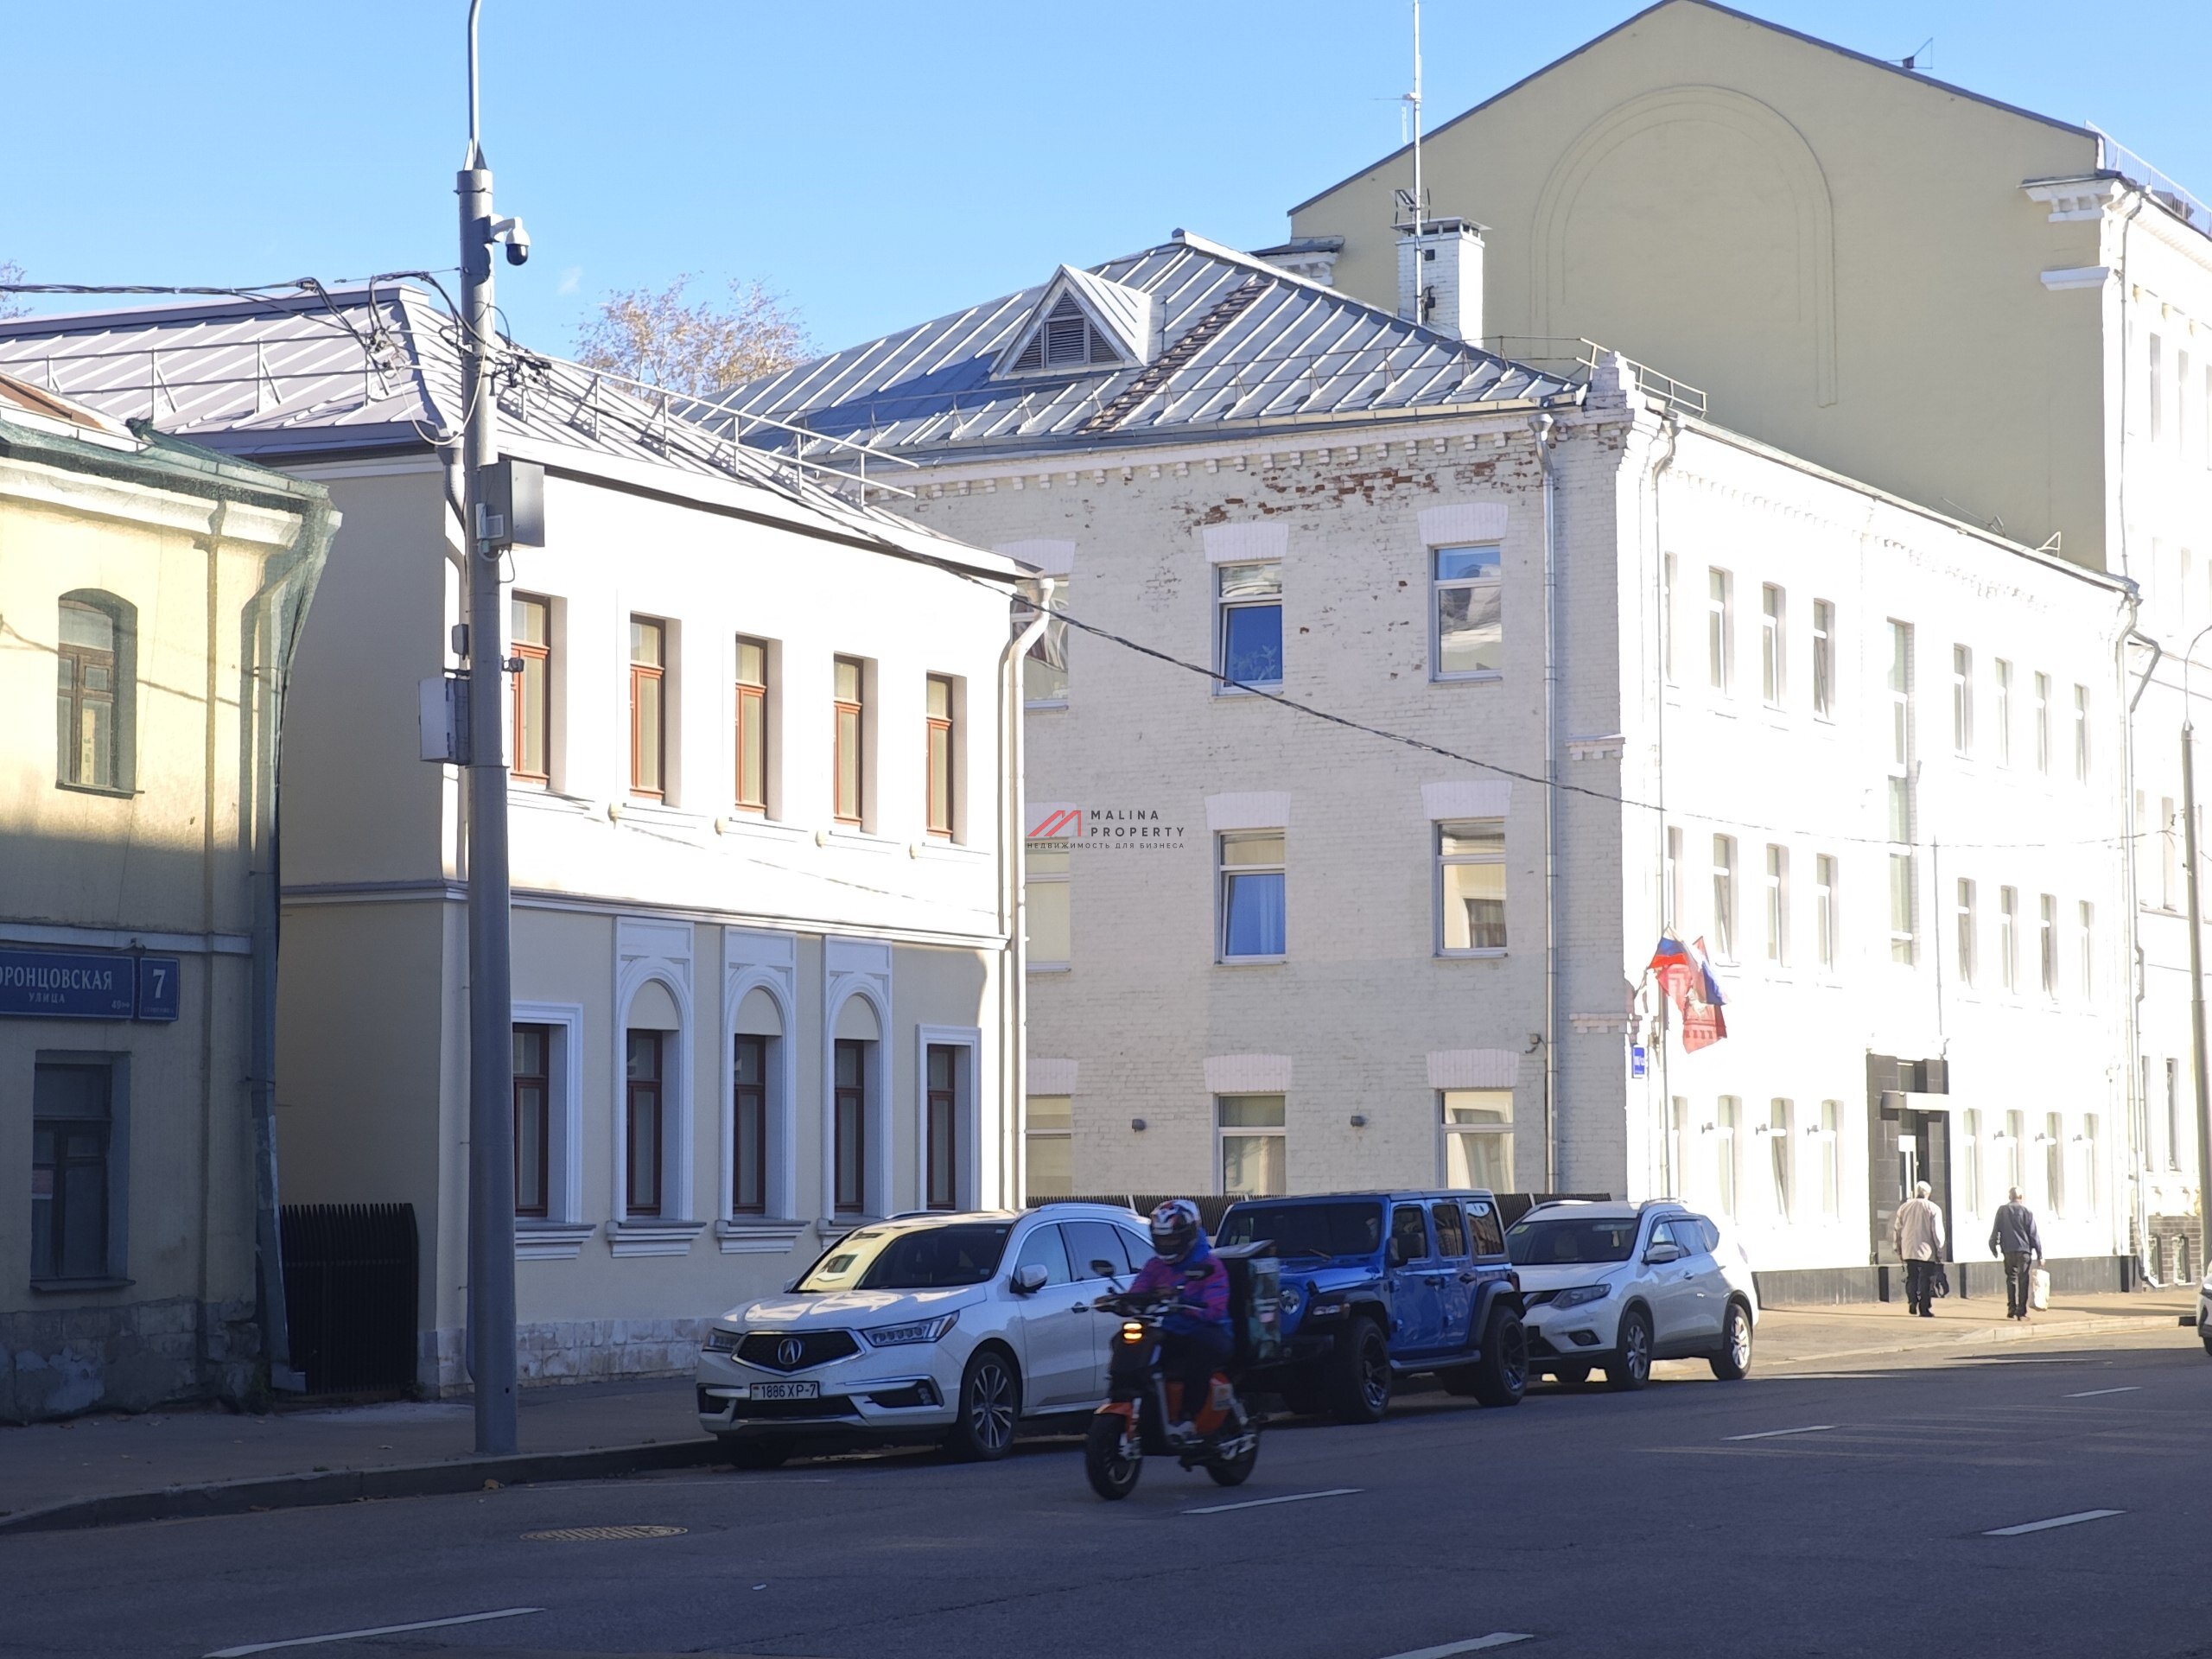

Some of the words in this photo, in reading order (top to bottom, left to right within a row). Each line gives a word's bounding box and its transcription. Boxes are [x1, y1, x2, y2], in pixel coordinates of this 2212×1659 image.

[152, 969, 166, 999] 7
[29, 992, 66, 1003] УЛИЦА
[761, 1385, 785, 1398] 1886
[787, 1383, 816, 1397] XP-7
